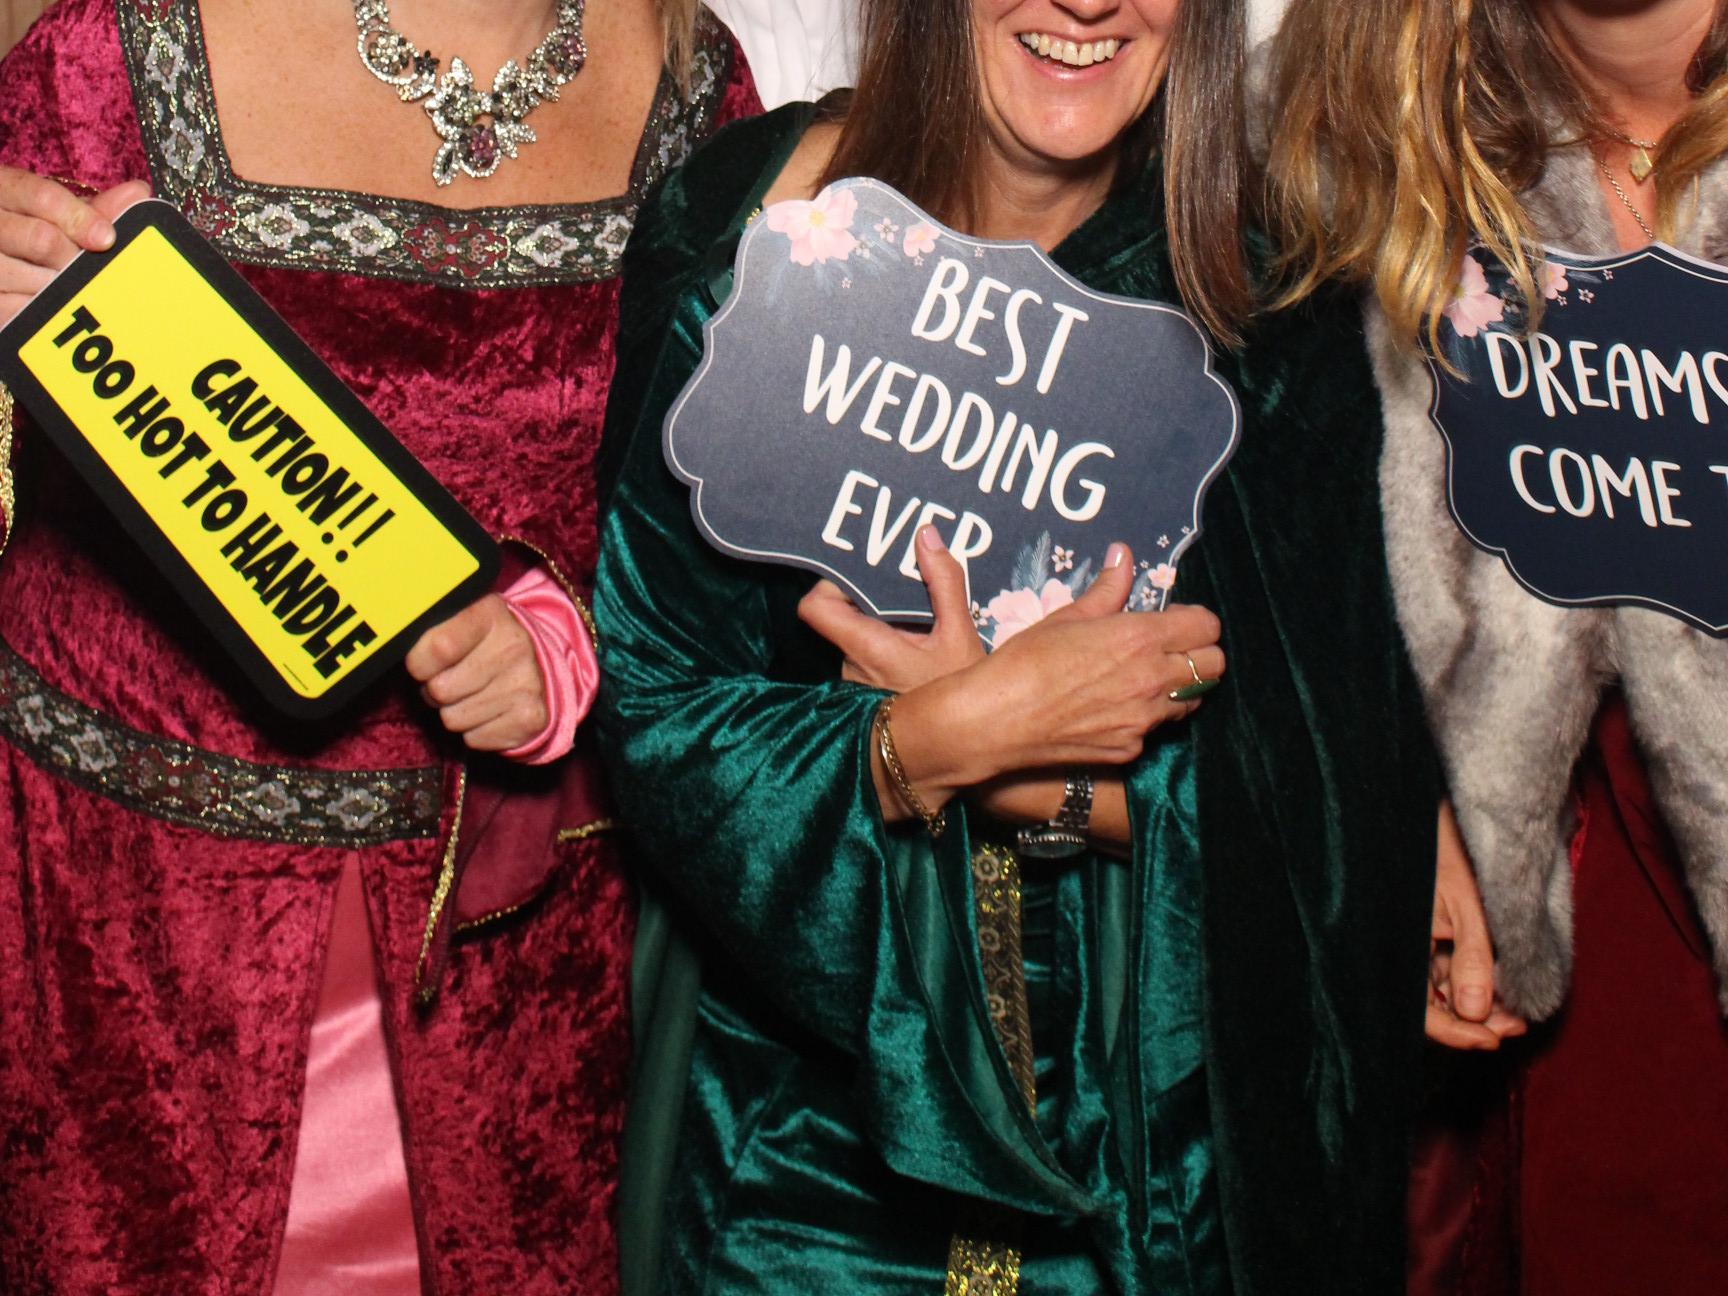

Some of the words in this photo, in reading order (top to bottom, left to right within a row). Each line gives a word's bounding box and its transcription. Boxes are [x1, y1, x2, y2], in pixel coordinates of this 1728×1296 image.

[911, 257, 1089, 394] BEST
[51, 305, 136, 399] TOO
[112, 384, 210, 480] HOT
[181, 461, 248, 532] TO
[219, 512, 378, 680] HANDLE
[190, 357, 396, 563] CAUTION!!
[803, 334, 1115, 521] WEDDING
[1509, 443, 1692, 528] COME
